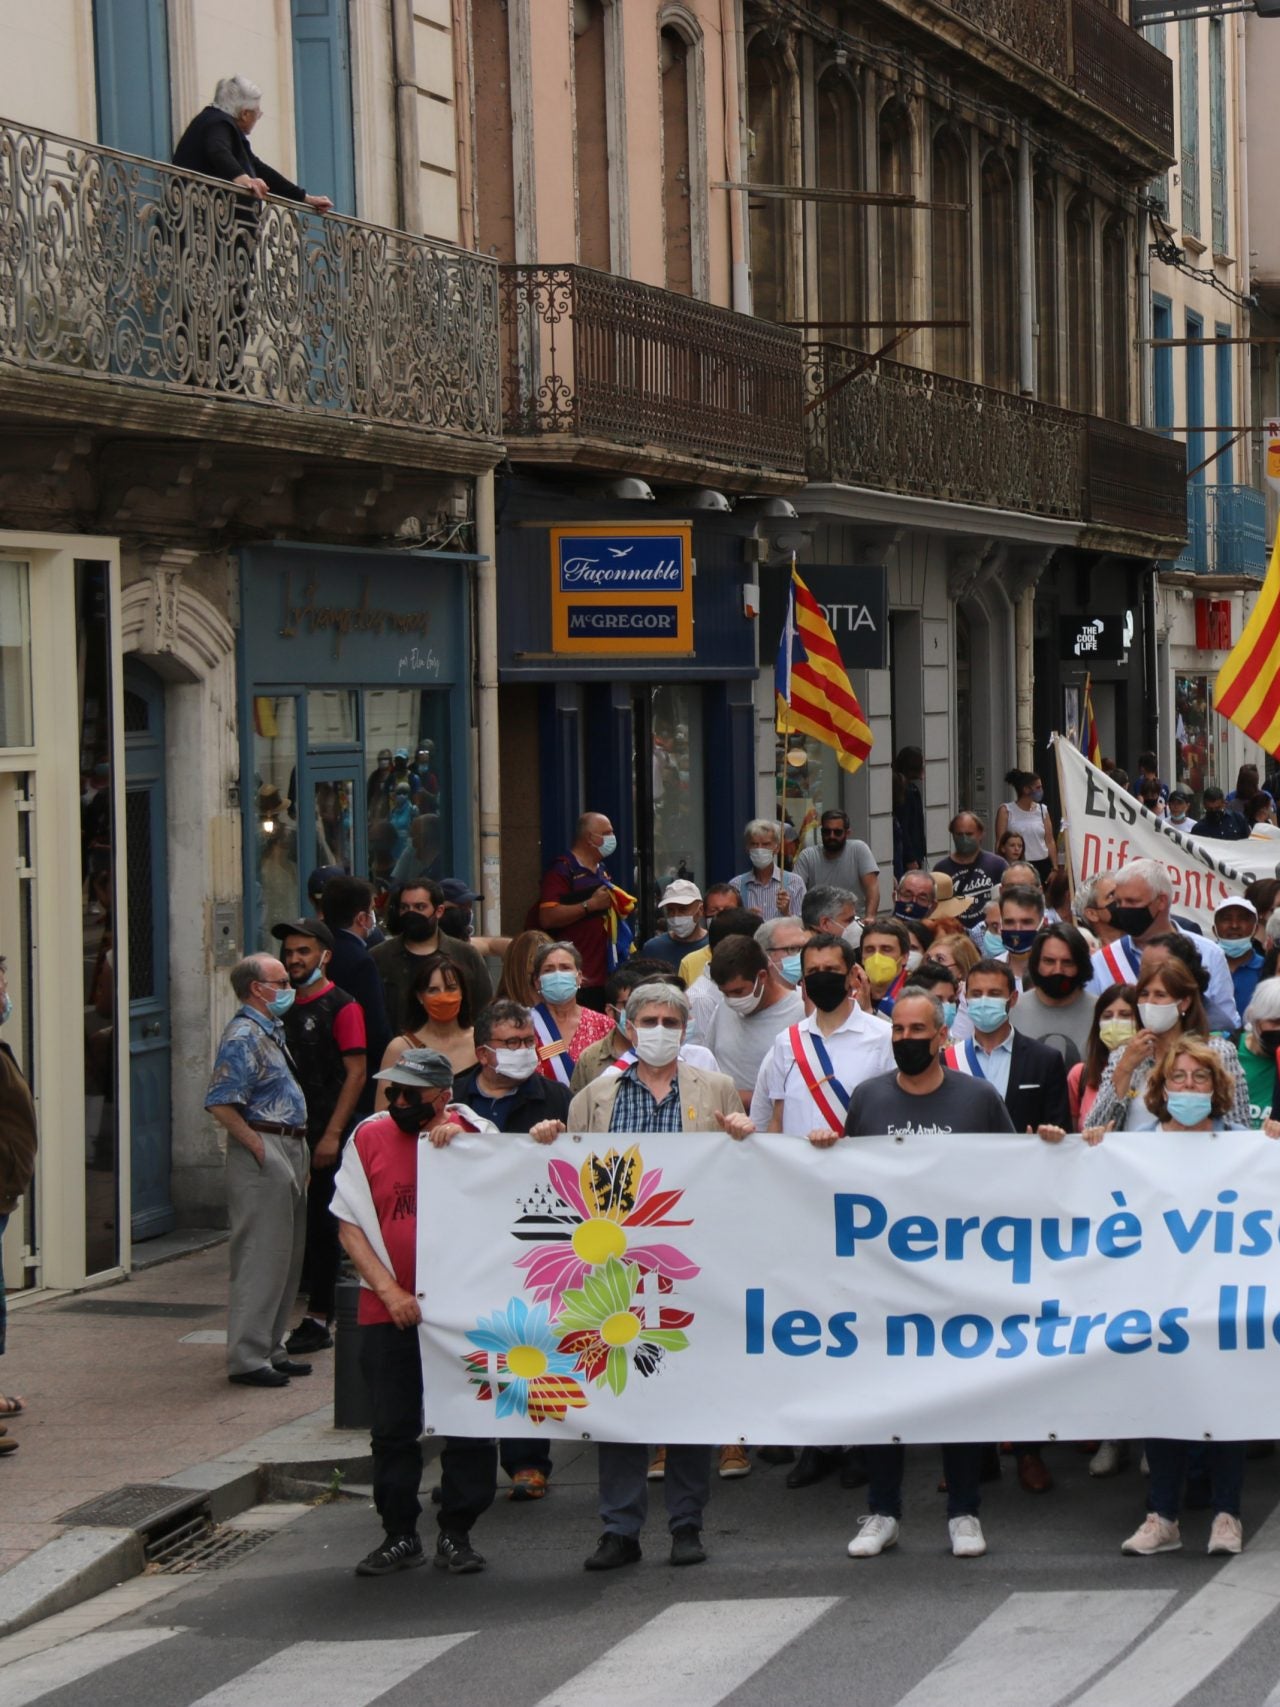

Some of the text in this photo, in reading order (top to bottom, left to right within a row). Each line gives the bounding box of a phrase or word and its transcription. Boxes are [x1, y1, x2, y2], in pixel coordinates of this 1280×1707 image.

[563, 557, 680, 585] Façonnable
[1077, 634, 1098, 643] COOL
[1082, 626, 1098, 635] THE
[1081, 642, 1098, 651] LIFE
[835, 1191, 1143, 1285] Perquè
[746, 1288, 859, 1358] les
[887, 1289, 1189, 1360] nostres
